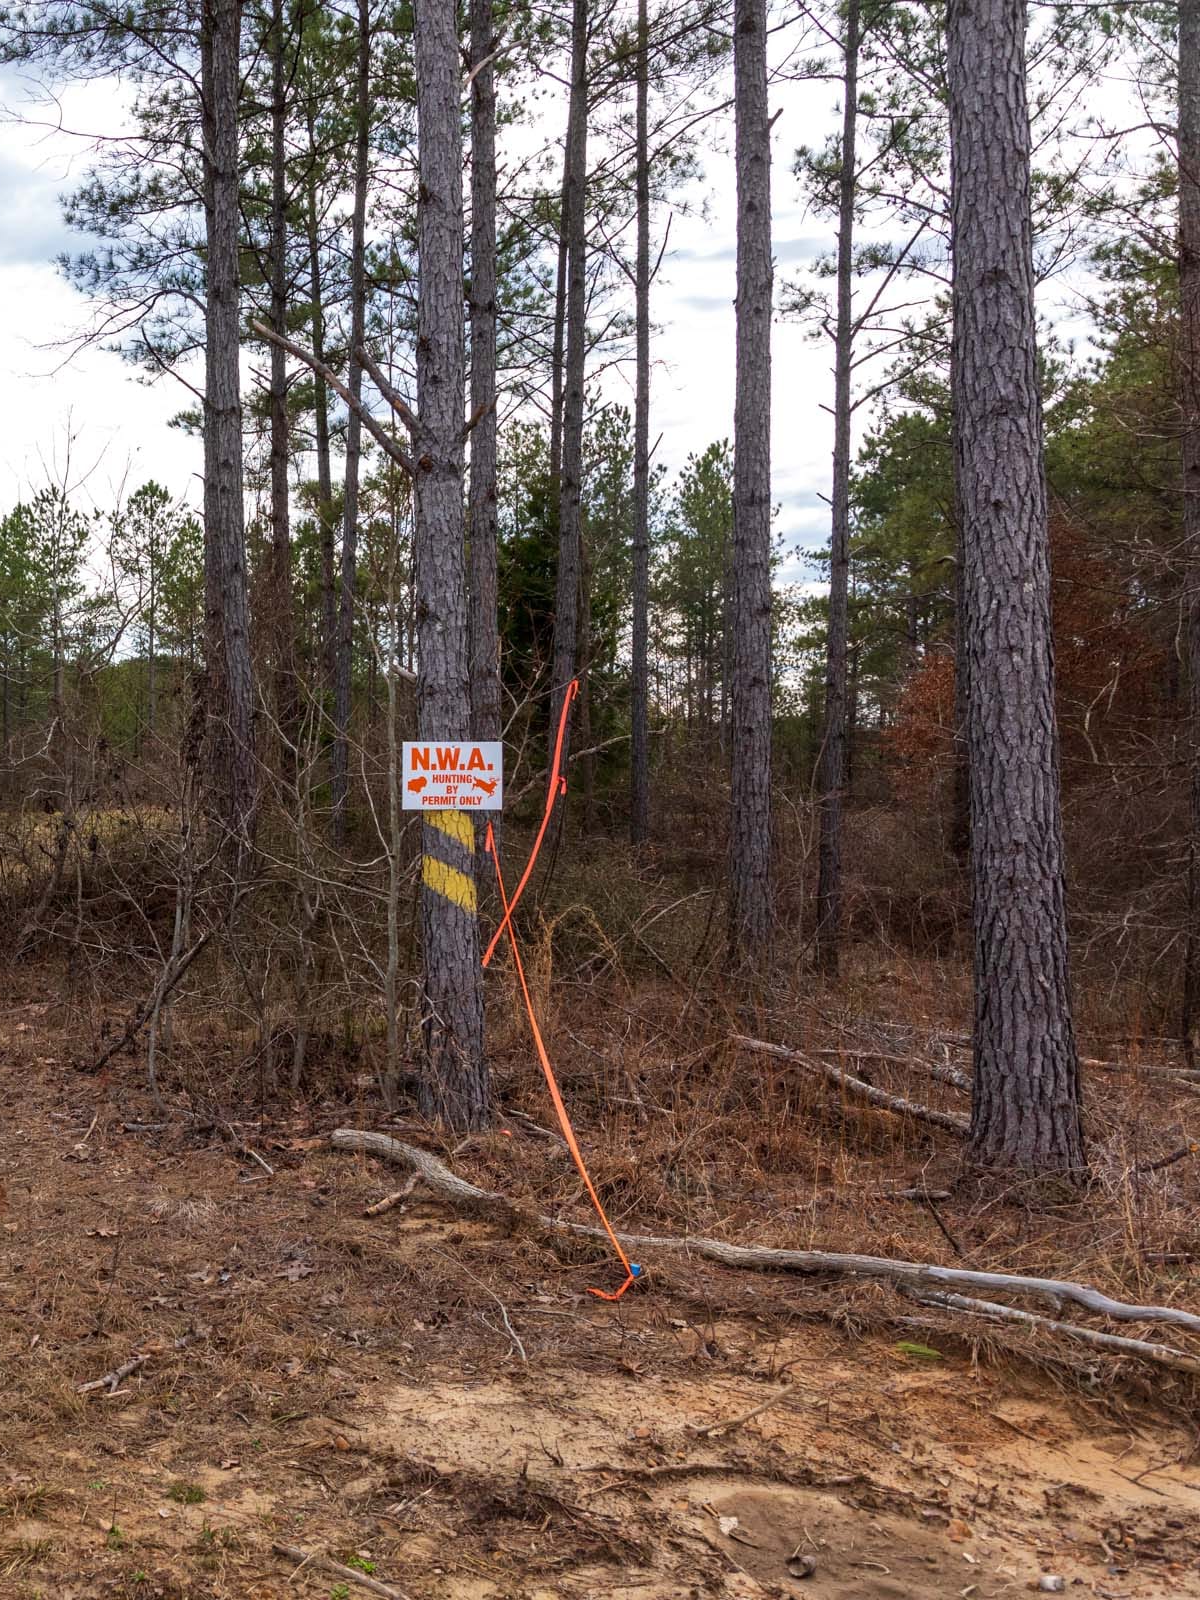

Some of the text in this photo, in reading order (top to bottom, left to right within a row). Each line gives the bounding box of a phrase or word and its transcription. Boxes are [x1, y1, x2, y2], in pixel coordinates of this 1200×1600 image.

[411, 747, 494, 771] N.W.A.
[432, 774, 473, 784] HUNTING
[446, 785, 458, 794] BY
[422, 796, 482, 805] PERMIT ONLY
